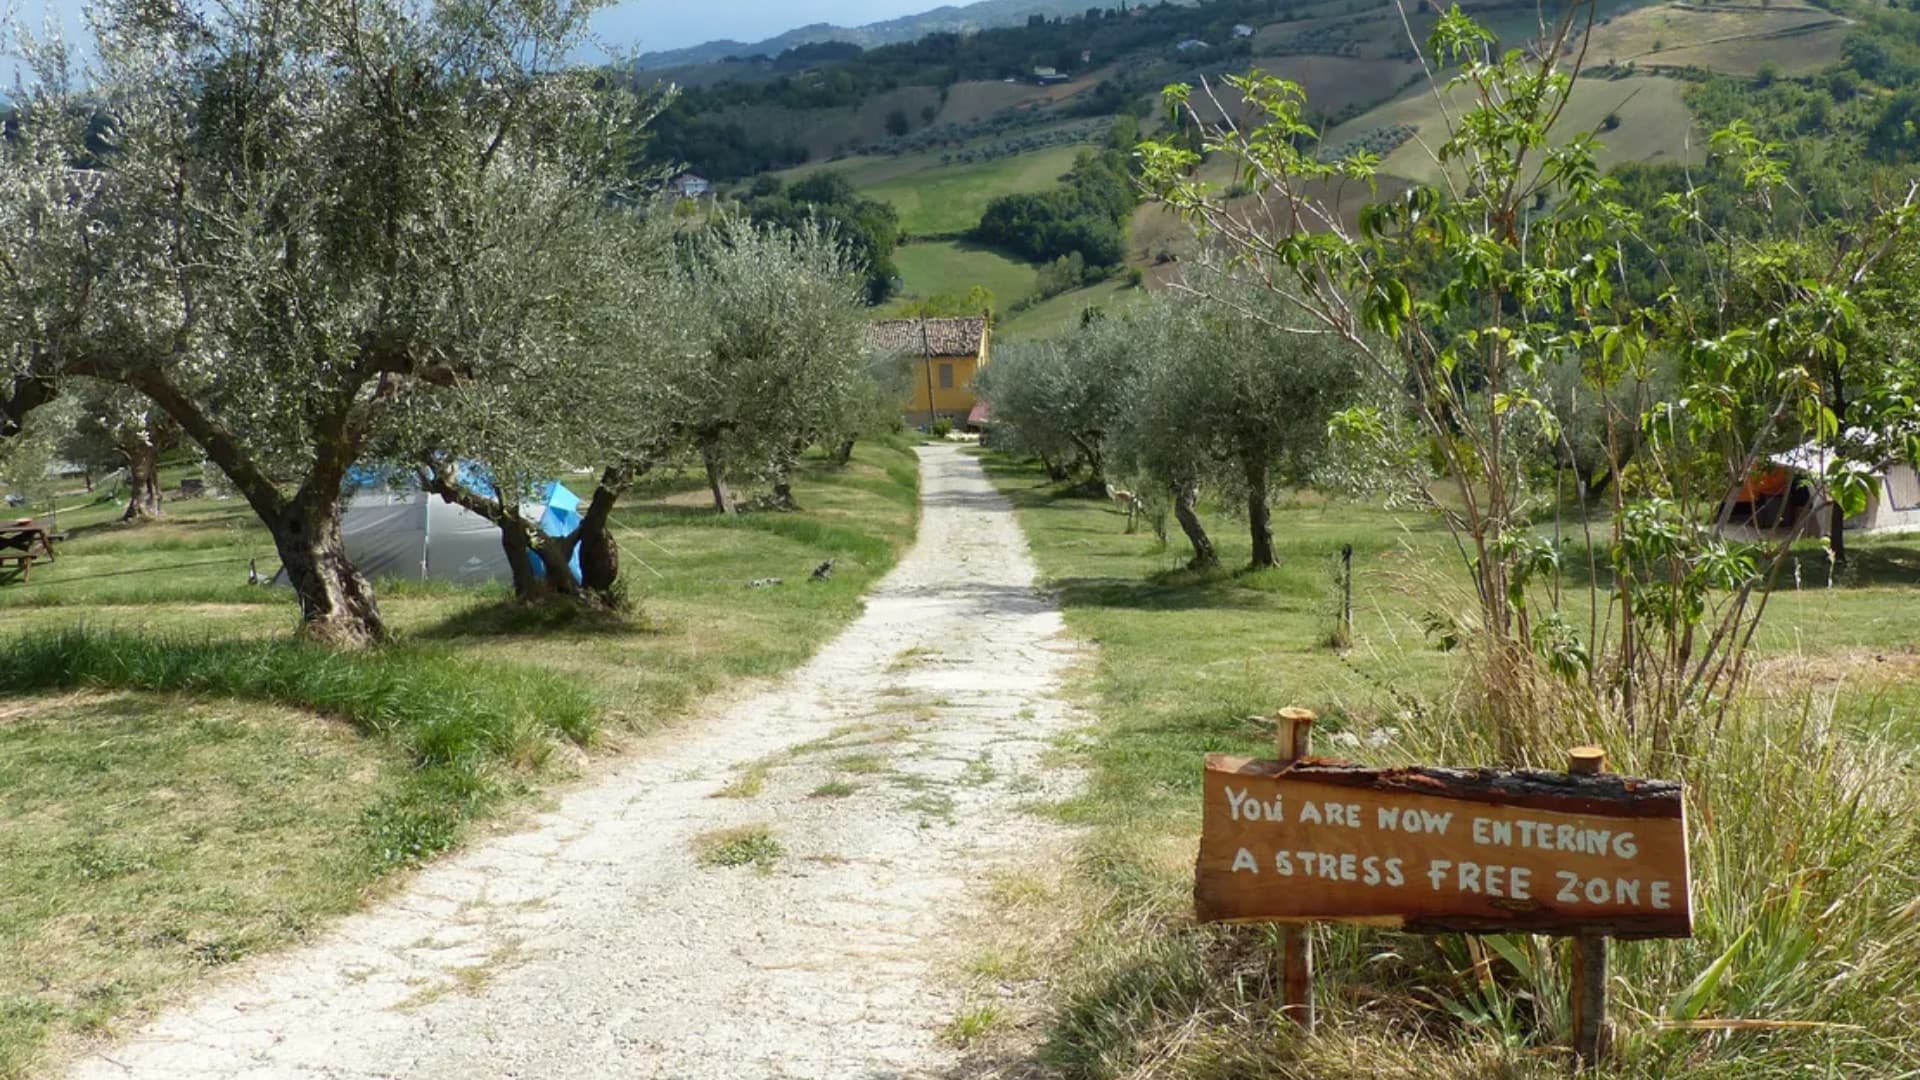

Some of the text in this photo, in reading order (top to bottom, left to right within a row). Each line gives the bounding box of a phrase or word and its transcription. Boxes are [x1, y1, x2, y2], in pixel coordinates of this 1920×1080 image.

[1299, 801, 1361, 828] ARE
[1378, 808, 1453, 835] NOW
[1473, 818, 1638, 860] ENTERING
[1231, 847, 1672, 909] A STRESS FREE ZONE
